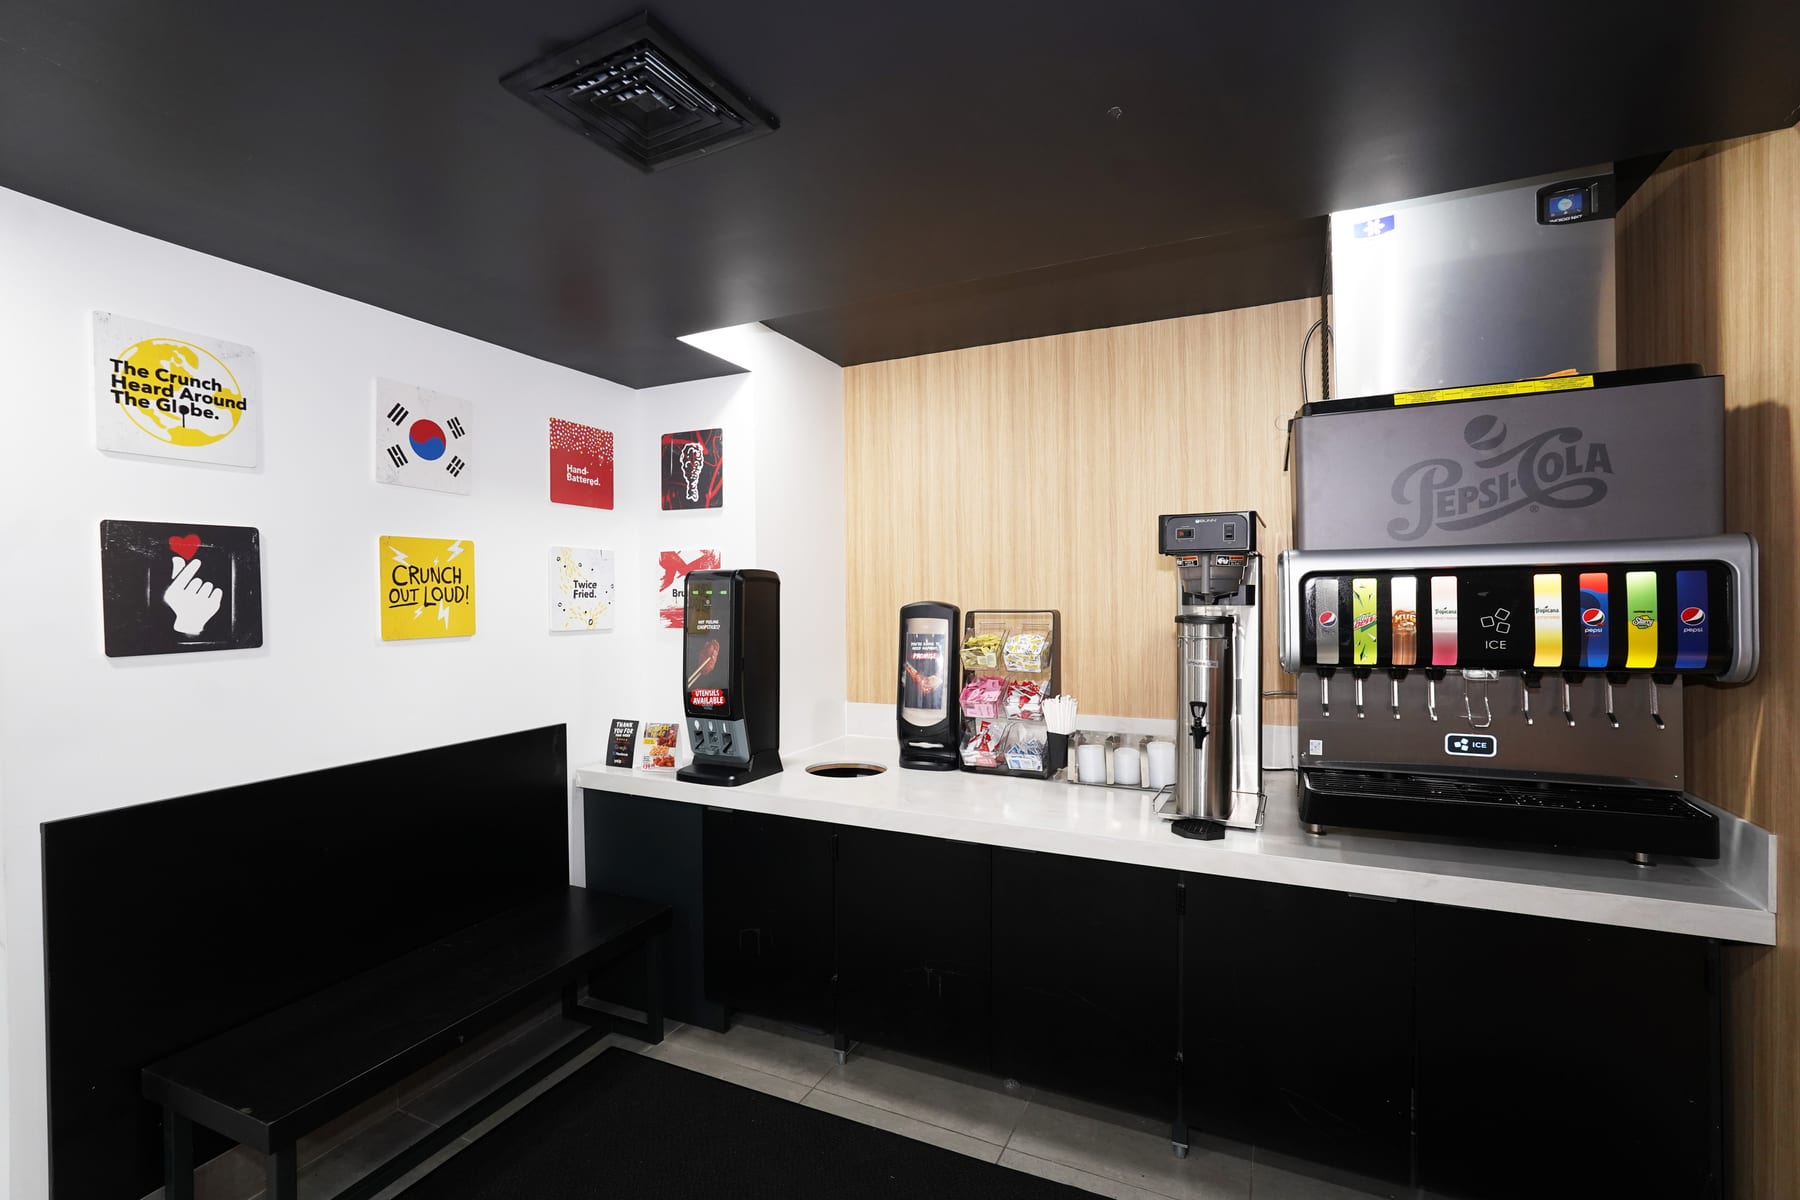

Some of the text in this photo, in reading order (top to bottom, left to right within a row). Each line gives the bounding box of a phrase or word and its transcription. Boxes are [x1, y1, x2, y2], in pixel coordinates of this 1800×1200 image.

[109, 358, 222, 392] The Crunch
[111, 374, 247, 411] Heard Around
[110, 389, 220, 427] The Globe.
[566, 463, 589, 476] Hand-
[566, 473, 601, 487] Battered.
[392, 564, 462, 586] CRUNCH
[573, 579, 597, 590] Twice
[389, 584, 469, 608] OUT LOUD!
[573, 589, 597, 599] Fried.
[1535, 605, 1560, 614] Tropicana
[1394, 614, 1416, 625] MUG
[1485, 640, 1507, 649] ICE
[695, 689, 720, 697] UTENSILS
[692, 696, 724, 705] AVAILABLE
[1472, 741, 1488, 749] ICE
